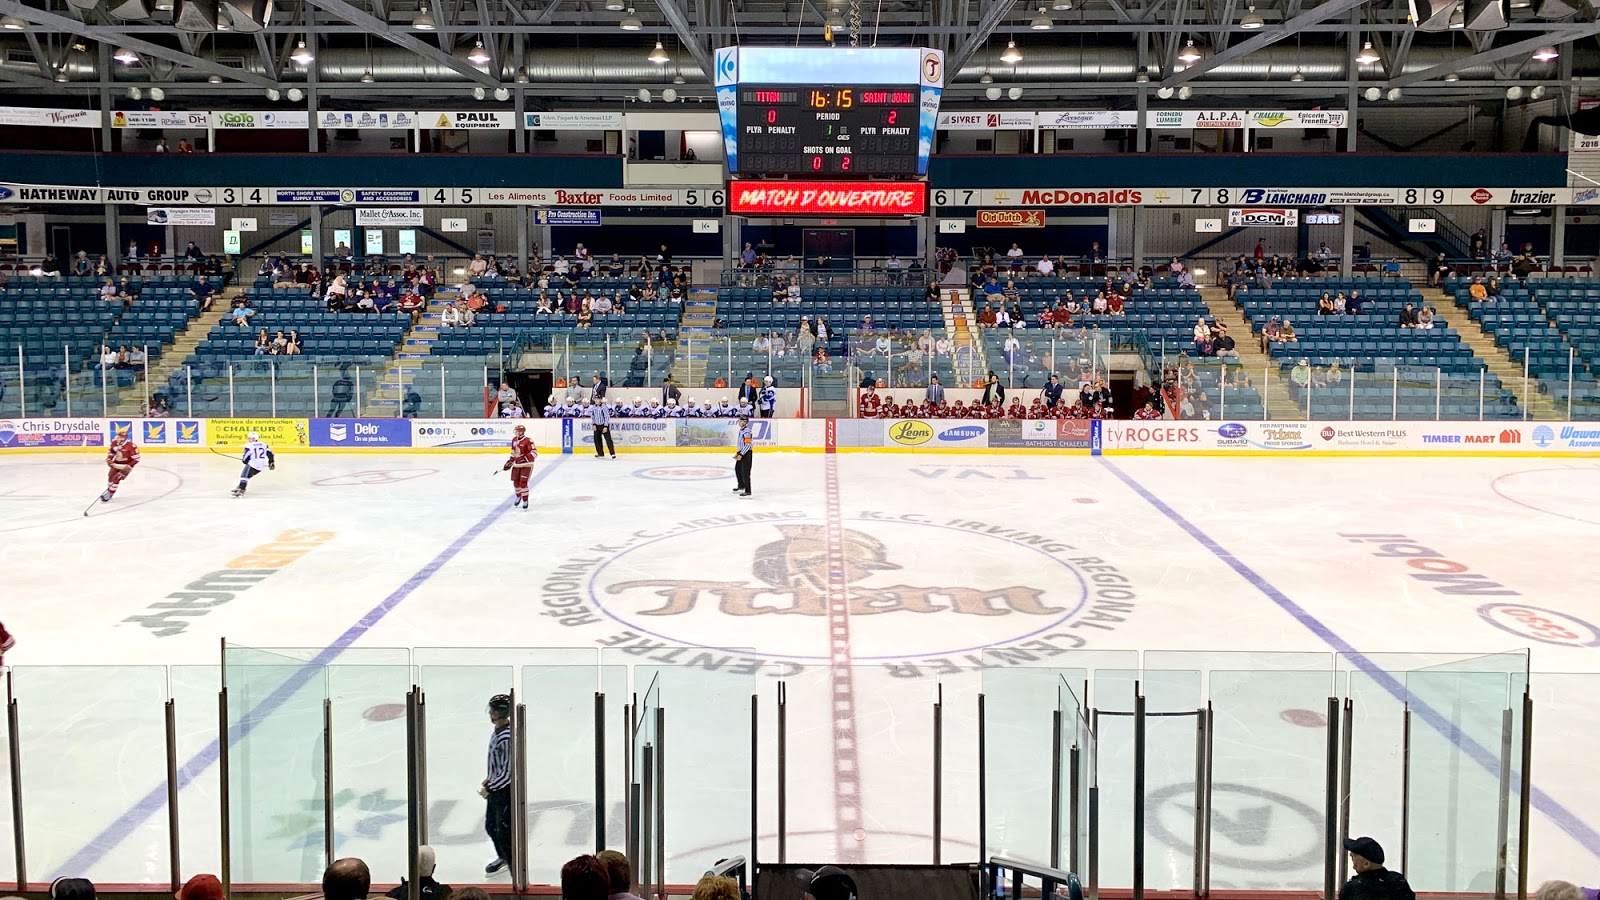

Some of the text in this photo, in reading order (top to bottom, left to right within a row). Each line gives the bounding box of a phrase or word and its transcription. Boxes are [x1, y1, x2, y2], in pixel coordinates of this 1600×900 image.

[755, 91, 780, 103] TITAN
[810, 89, 852, 108] 16:15
[863, 92, 911, 103] SAINT JOHN
[922, 101, 937, 109] IRVING
[456, 113, 498, 121] PAUL
[767, 110, 777, 123] 0
[816, 112, 841, 121] PERIOD
[888, 110, 897, 124] 2
[951, 115, 981, 123] SIVRET
[1197, 112, 1242, 121] A.L.P.A.
[746, 126, 796, 134] PLYR PENALTY
[860, 127, 911, 135] PLYR PENALTY
[803, 146, 852, 154] SHOTS ON GOAL
[1581, 140, 1599, 148] 2018
[813, 157, 850, 170] 0 2
[20, 189, 189, 201] HATHEWAY AUTO GROUP
[223, 188, 235, 204] 3
[249, 188, 262, 204] 4
[433, 189, 446, 203] 4
[461, 189, 473, 204] 5
[488, 189, 673, 205] Les Aliments Baxter Foods Limited
[686, 190, 697, 205] 5
[712, 190, 724, 205] 6
[739, 189, 800, 206] MATCH
[817, 190, 914, 206] OUVERTURE
[935, 190, 947, 205] 6
[962, 190, 974, 205] 7
[1021, 189, 1142, 204] McDonald's
[1190, 189, 1202, 204] 7
[1217, 188, 1229, 204] 8
[1405, 189, 1417, 204] 8
[1432, 189, 1444, 204] 9
[1510, 190, 1555, 203] brazier
[982, 212, 1022, 223] Old Dutch
[1245, 214, 1282, 222] DCM
[1306, 215, 1340, 224] BAR
[22, 421, 50, 432] Chris
[54, 420, 100, 433] Drysdale
[354, 422, 377, 434] Delo
[621, 423, 667, 431] AUTO GROUP
[1422, 435, 1495, 443] TIMBER MART
[253, 447, 265, 459] 12
[1337, 532, 1522, 596] Mobil
